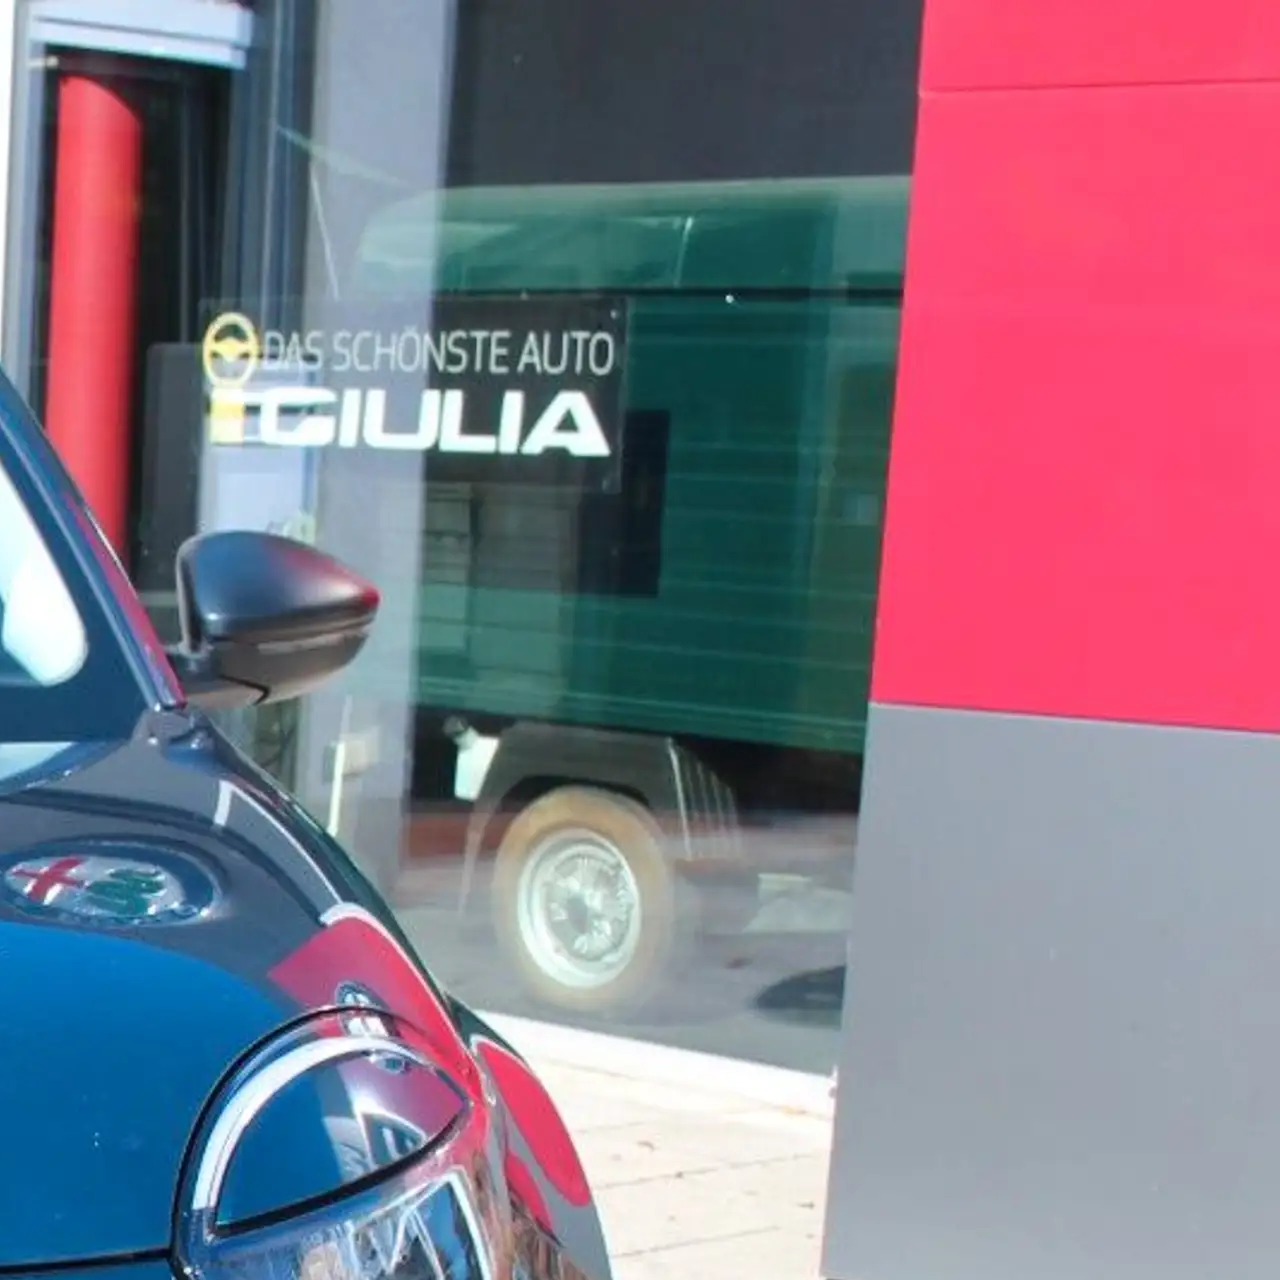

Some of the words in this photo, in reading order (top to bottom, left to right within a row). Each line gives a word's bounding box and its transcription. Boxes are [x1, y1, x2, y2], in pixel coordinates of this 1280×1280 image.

[263, 330, 325, 372] DAS
[333, 323, 512, 375] SCHÖNSTE
[516, 330, 616, 377] AUTO
[258, 387, 612, 457] GIULIA
